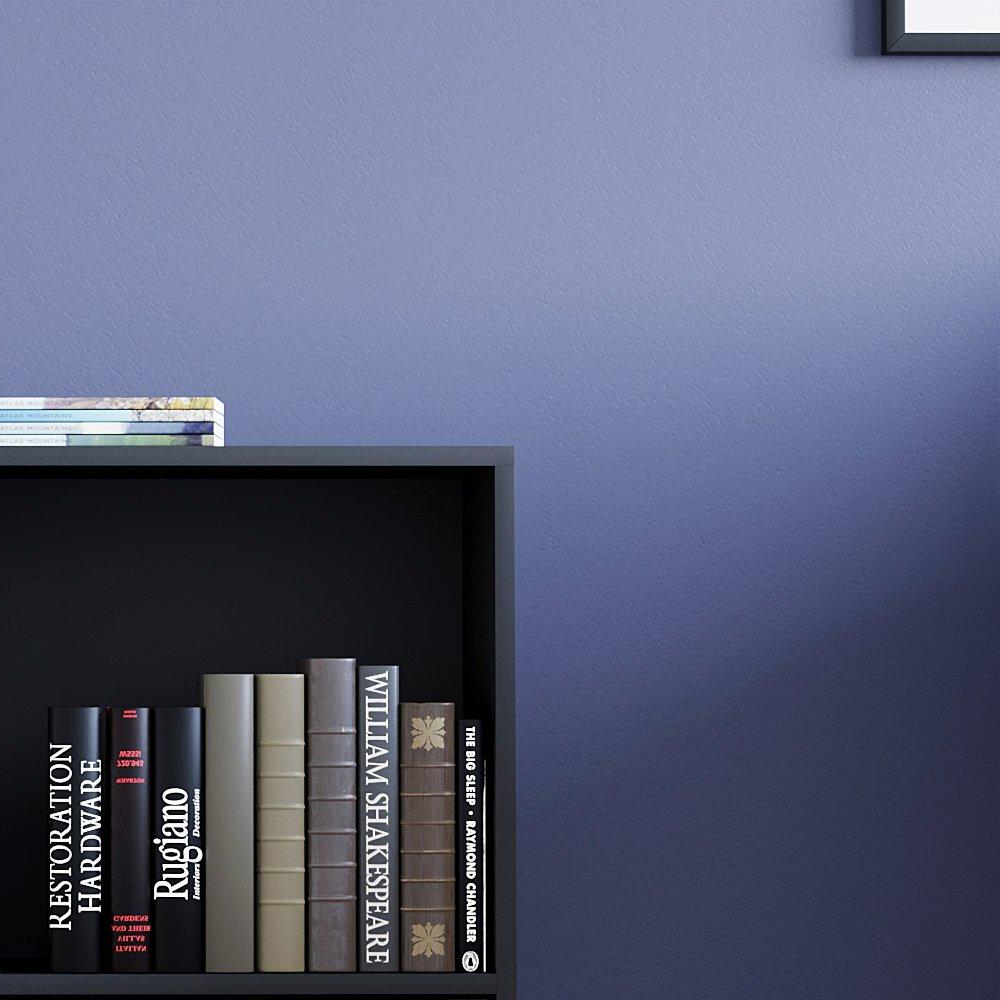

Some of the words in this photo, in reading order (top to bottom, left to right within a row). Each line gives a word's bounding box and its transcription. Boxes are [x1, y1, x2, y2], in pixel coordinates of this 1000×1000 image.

[365, 670, 389, 786] WILLIAM
[465, 726, 476, 747] THE
[465, 750, 477, 771] BIG
[465, 774, 477, 806] SLEEP
[49, 742, 72, 931] RESTORATION
[77, 759, 102, 914] HARDWARE
[192, 788, 201, 838] Decoration
[153, 787, 203, 901] Rugiano
[465, 820, 477, 880] RAYMOND
[365, 792, 390, 964] SHAKESPEARE
[465, 882, 477, 943] CHANDLER
